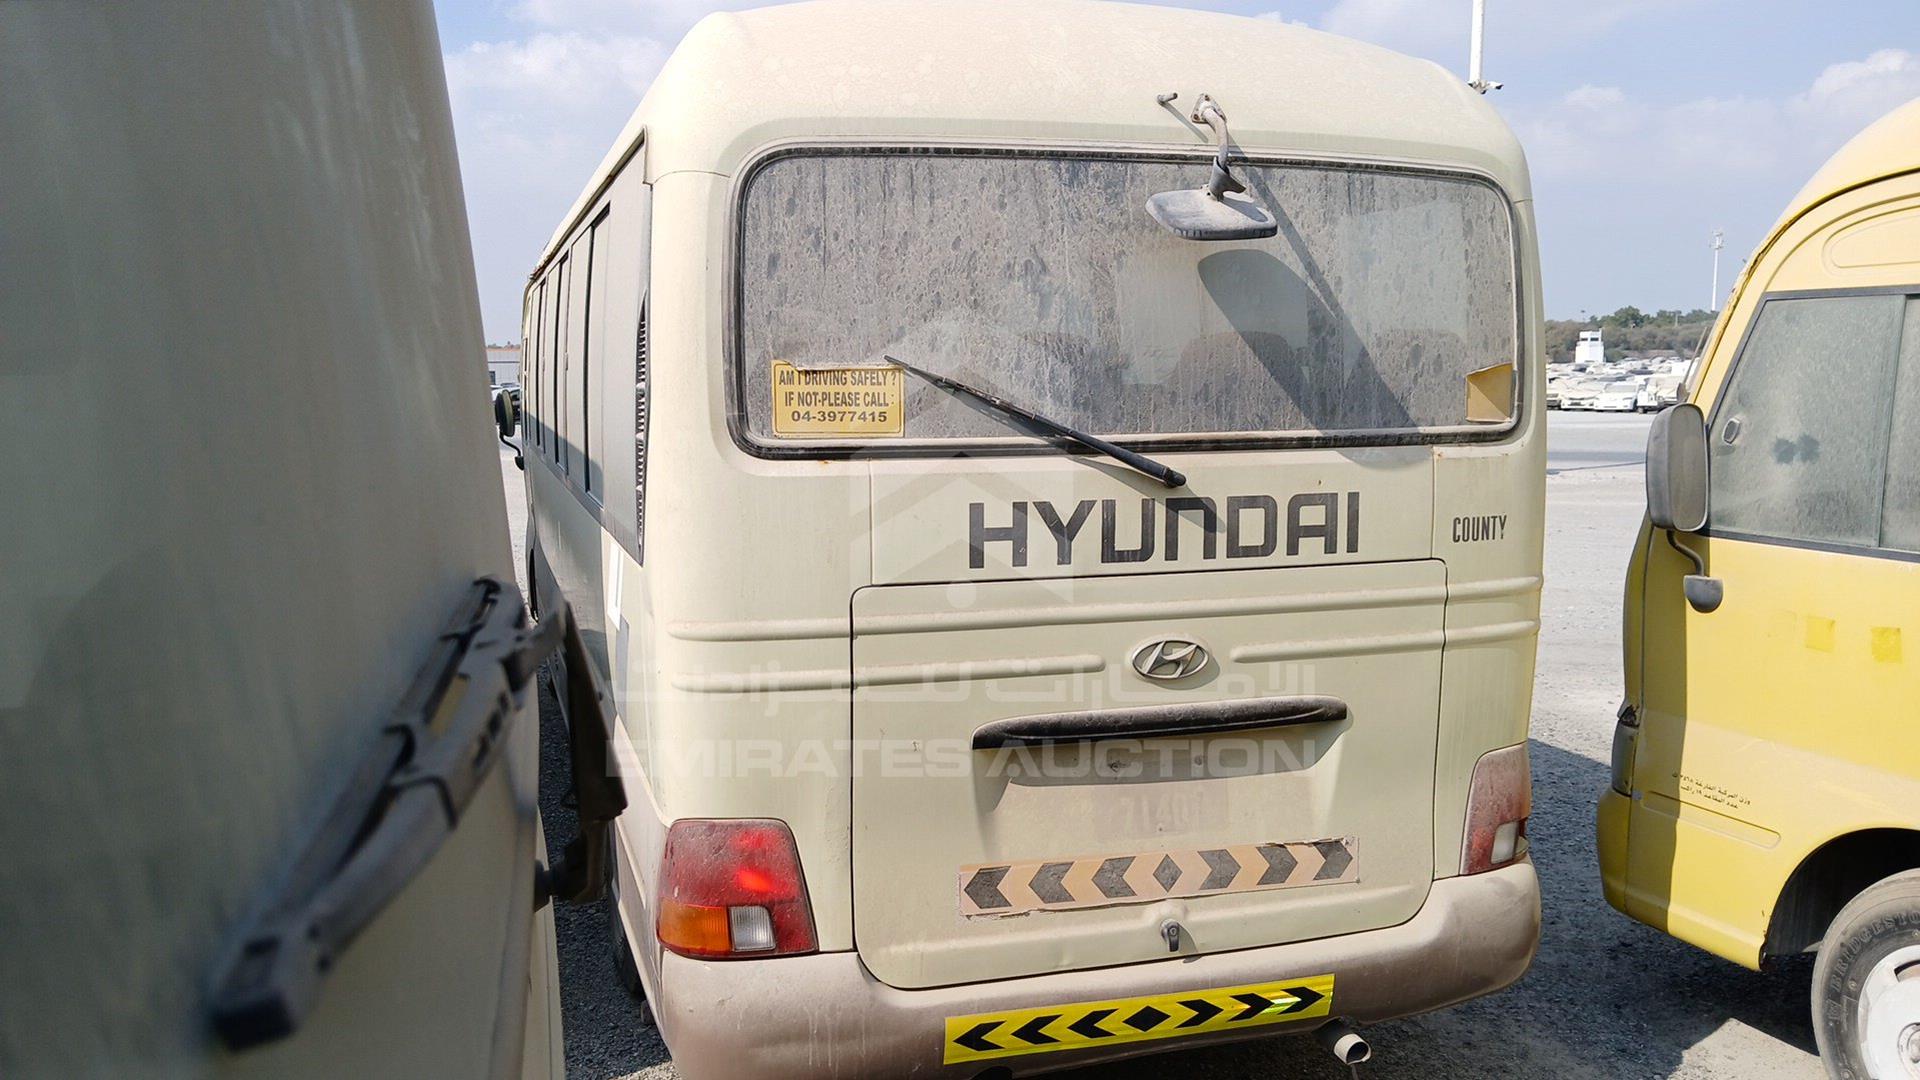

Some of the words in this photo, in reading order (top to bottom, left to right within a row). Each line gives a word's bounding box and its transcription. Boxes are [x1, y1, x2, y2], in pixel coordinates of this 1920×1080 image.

[779, 370, 795, 386] AM
[797, 370, 801, 386] I
[804, 370, 848, 386] DRIVING
[850, 370, 888, 386] SAFELY
[784, 392, 794, 407] IF
[797, 391, 860, 407] NOT-PLEASE
[863, 391, 889, 407] CALL
[791, 410, 887, 423] 04-3977415
[969, 491, 1359, 569] HYUNDAI
[1452, 514, 1507, 543] COUNTY
